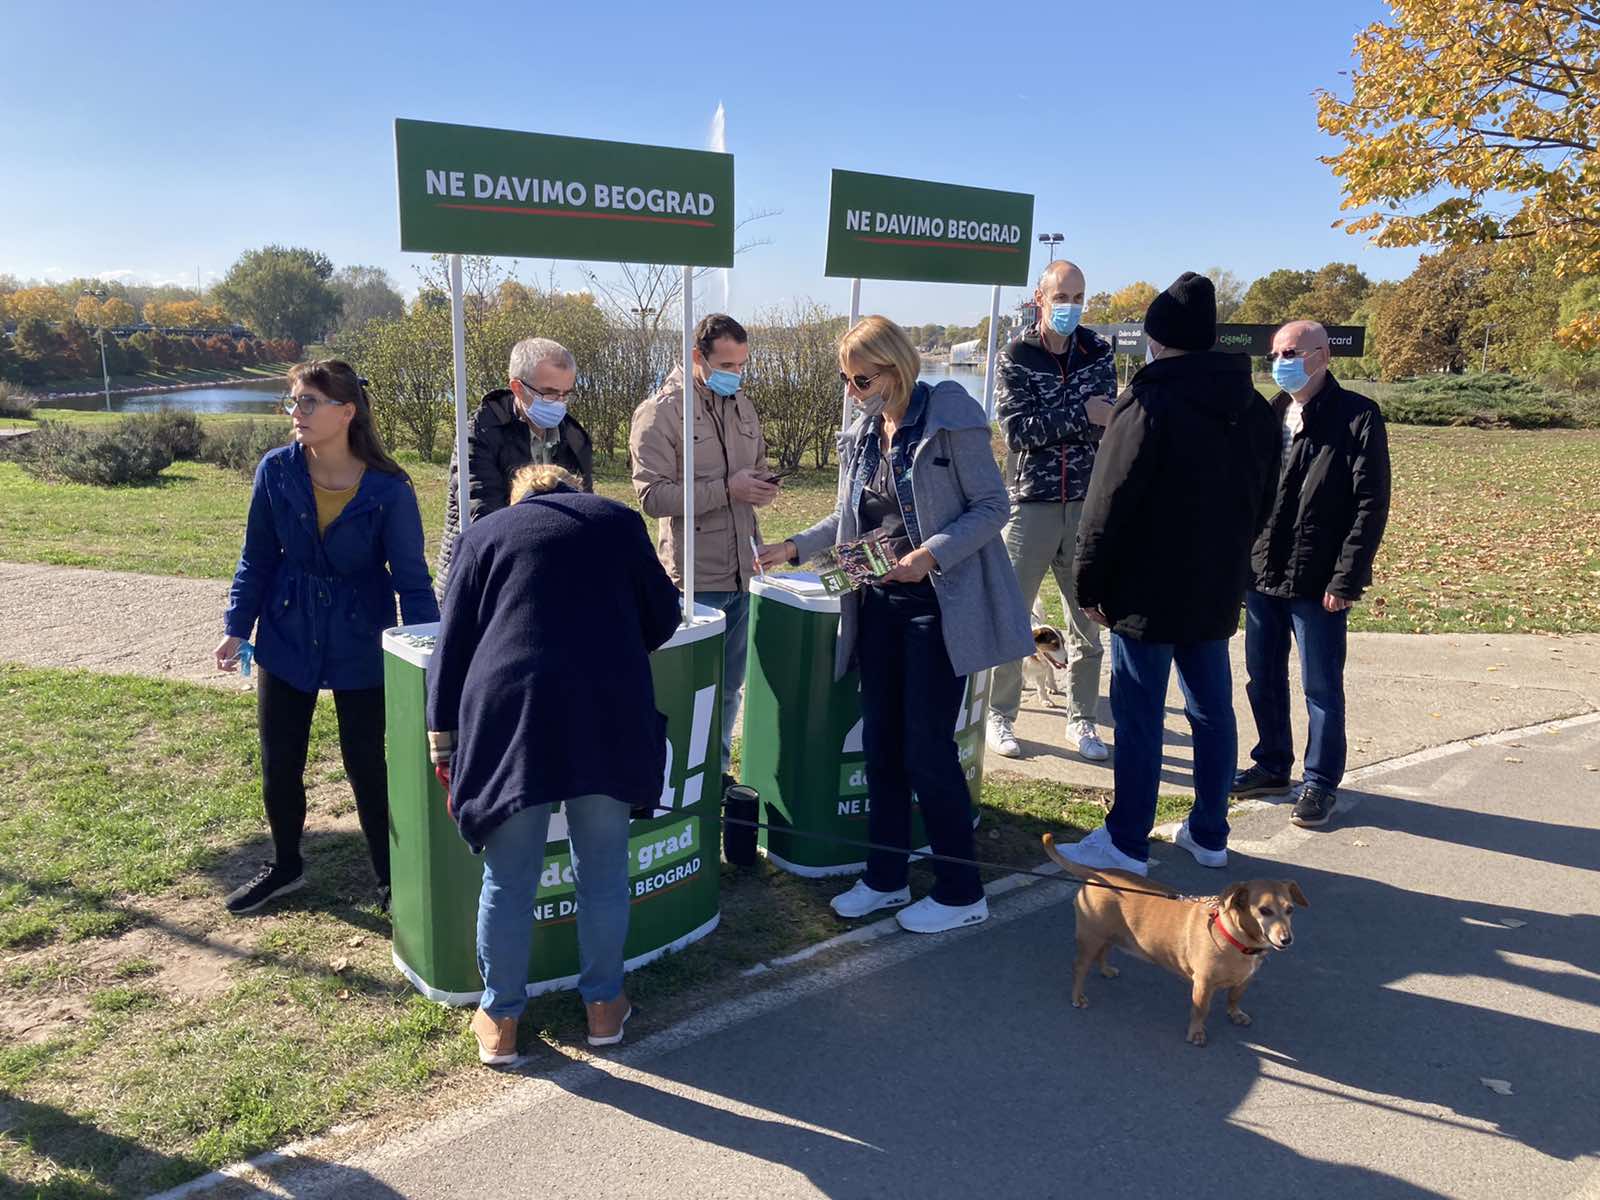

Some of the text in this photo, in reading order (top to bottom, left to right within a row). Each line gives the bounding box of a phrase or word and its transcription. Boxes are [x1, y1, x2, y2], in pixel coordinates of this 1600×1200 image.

[425, 169, 715, 216] NE DAVIMO BEOGRAD
[846, 209, 1021, 244] NE DAVIMO BEOGRAD
[1328, 336, 1352, 345] rcard
[837, 800, 860, 816] NE
[638, 824, 693, 870] grad
[636, 857, 701, 897] BEOGRAD
